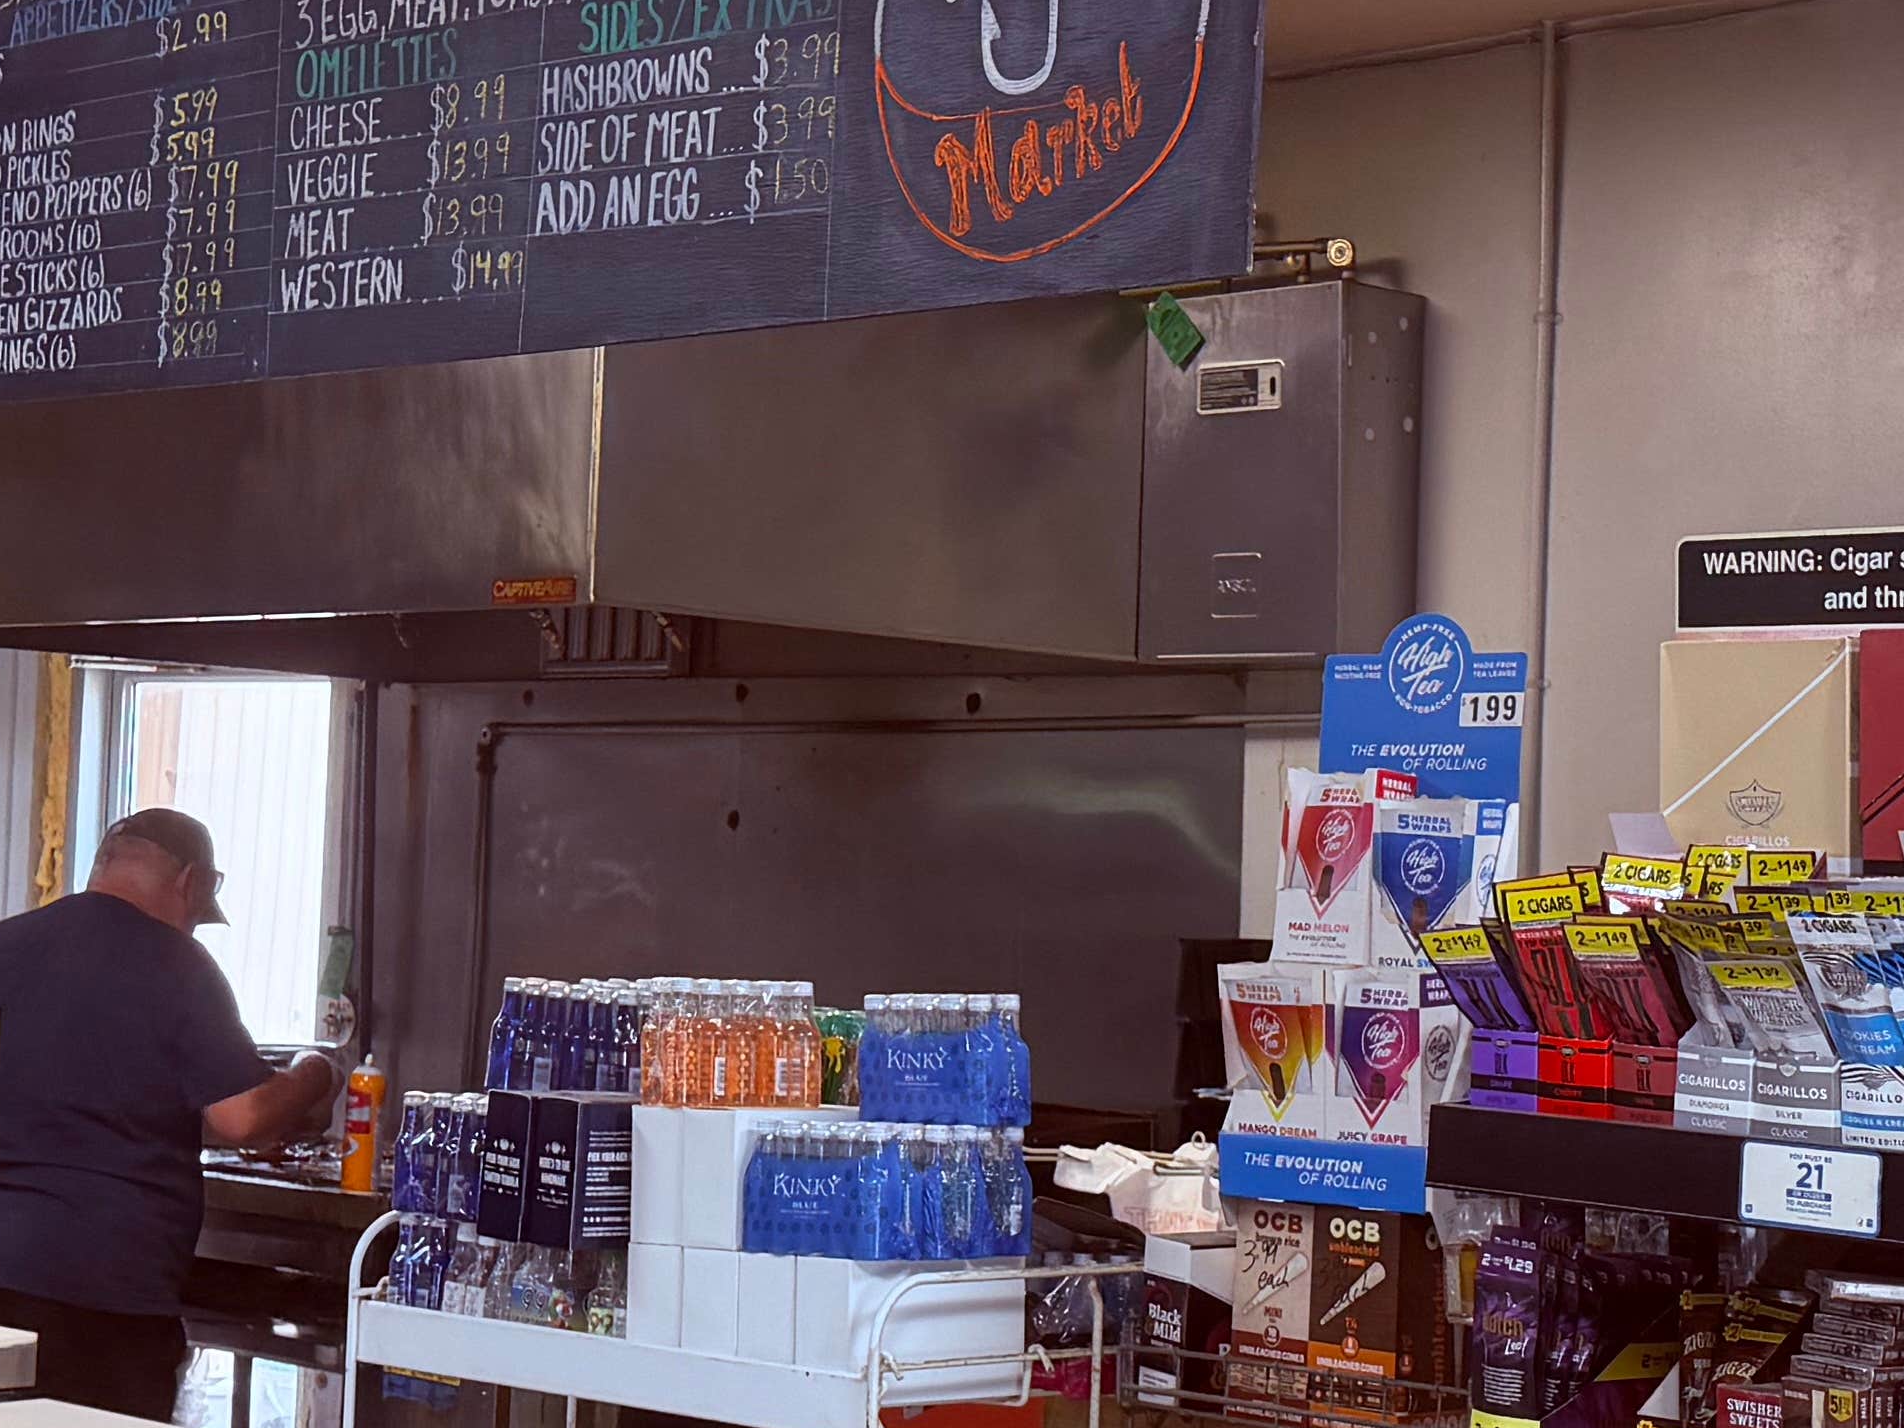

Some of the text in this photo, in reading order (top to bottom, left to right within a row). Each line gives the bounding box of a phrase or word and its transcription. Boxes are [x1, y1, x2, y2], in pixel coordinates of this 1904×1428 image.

[296, 27, 458, 102] OMELETTES
[542, 46, 712, 117] HASHBROWNS
[23, 110, 75, 147] RINGS
[934, 40, 1144, 236] Market
[7, 150, 71, 188] PICKLES
[1703, 549, 1823, 574] WARNING:
[1830, 547, 1893, 576] Cigar
[1824, 587, 1867, 610] and
[1352, 744, 1464, 756] THE EVOLUTION
[1403, 758, 1487, 770] OF ROLLING
[1757, 1082, 1827, 1102] CIGARILLOS
[1797, 1163, 1824, 1190] 21
